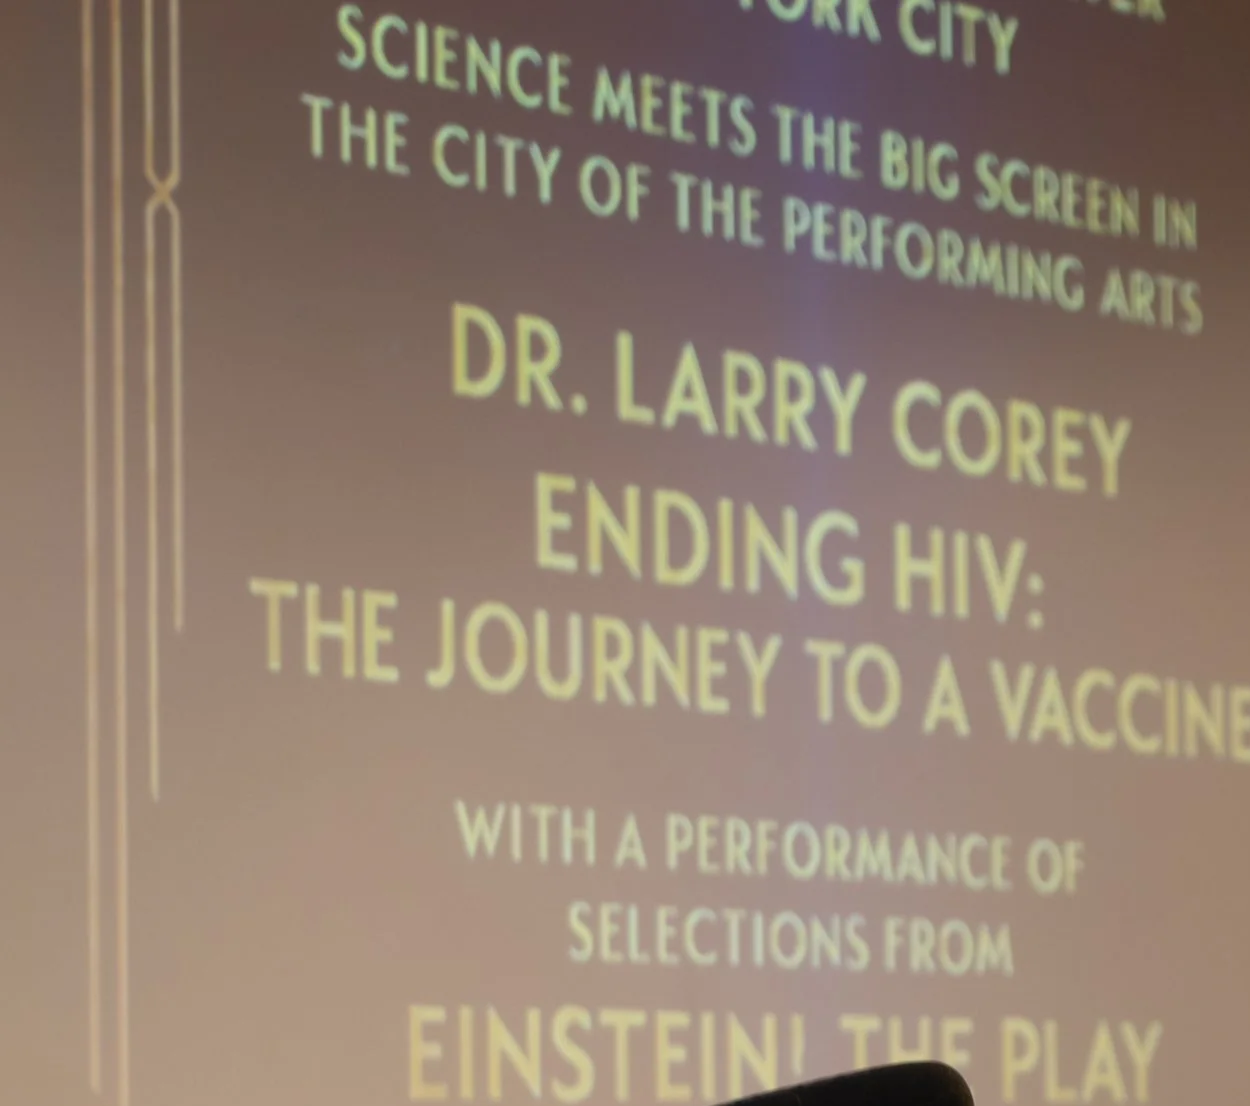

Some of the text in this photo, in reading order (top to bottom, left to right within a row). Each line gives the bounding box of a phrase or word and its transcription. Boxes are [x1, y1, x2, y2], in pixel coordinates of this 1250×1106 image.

[897, 0, 1019, 75] CITY
[337, 4, 1198, 250] SCIENCE MEETS THE BIG SCREEN IN
[301, 92, 1204, 335] THE CITY OF THE PERFORMING ARTS
[451, 302, 1132, 498] DR. LARRY COREY
[535, 470, 1045, 630] ENDING HIV:
[249, 576, 400, 684] THE
[425, 597, 783, 718] JOURNEY
[805, 636, 903, 729] TO
[922, 653, 972, 737] A
[455, 798, 1087, 894] WITH A PERFORMANCE OF
[567, 900, 1016, 976] SELECTIONS FROM
[1001, 1016, 1164, 1105] PLAY
